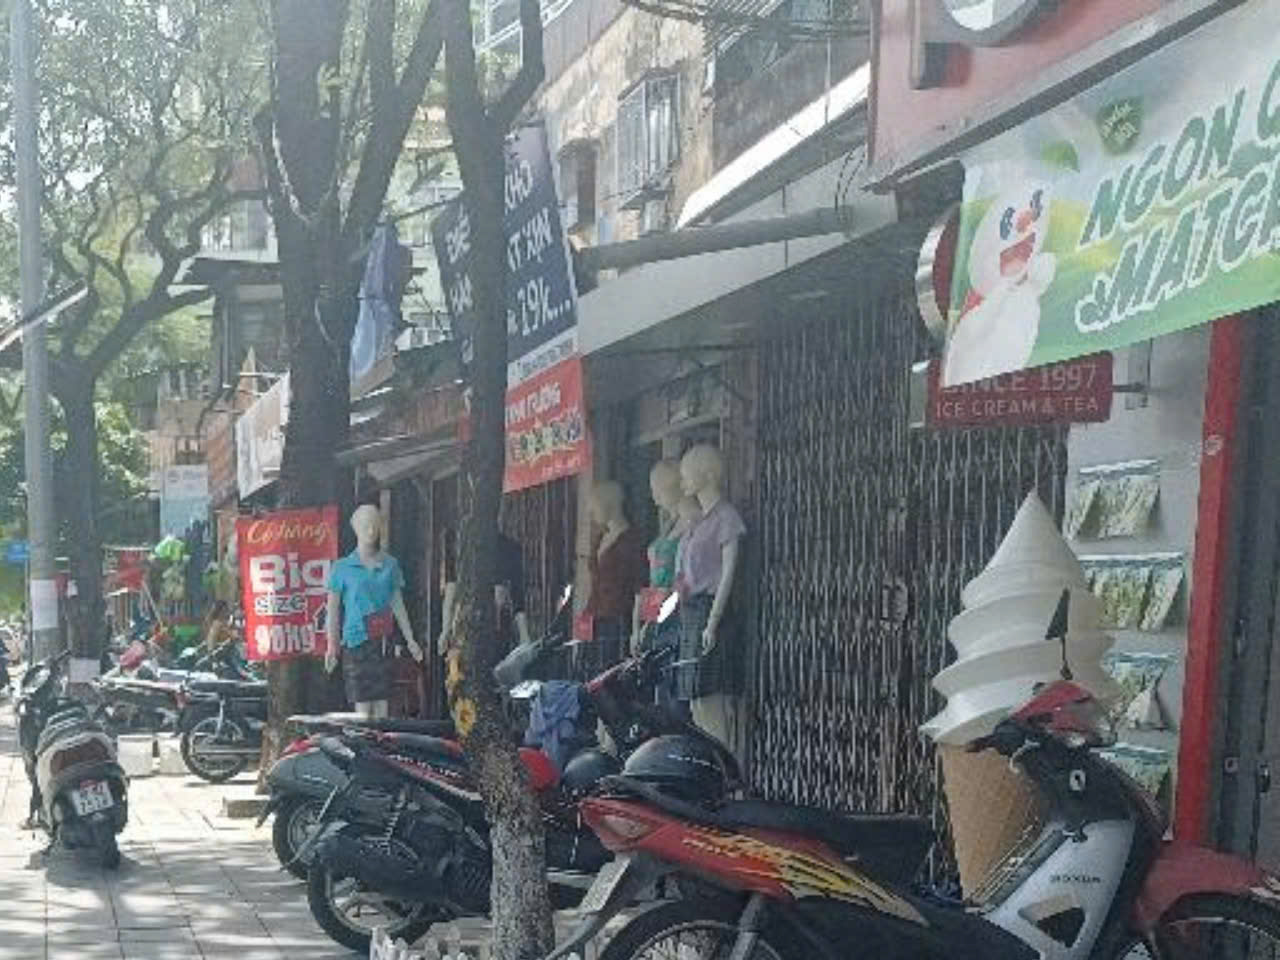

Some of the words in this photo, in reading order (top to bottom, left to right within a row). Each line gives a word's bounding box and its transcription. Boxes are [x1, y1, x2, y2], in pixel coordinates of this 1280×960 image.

[1077, 86, 1246, 249] NGON
[1039, 363, 1098, 391] 1997
[935, 401, 966, 419] ICE
[971, 399, 1037, 417] CREAM
[1063, 397, 1098, 413] TEA
[249, 552, 331, 597] Big
